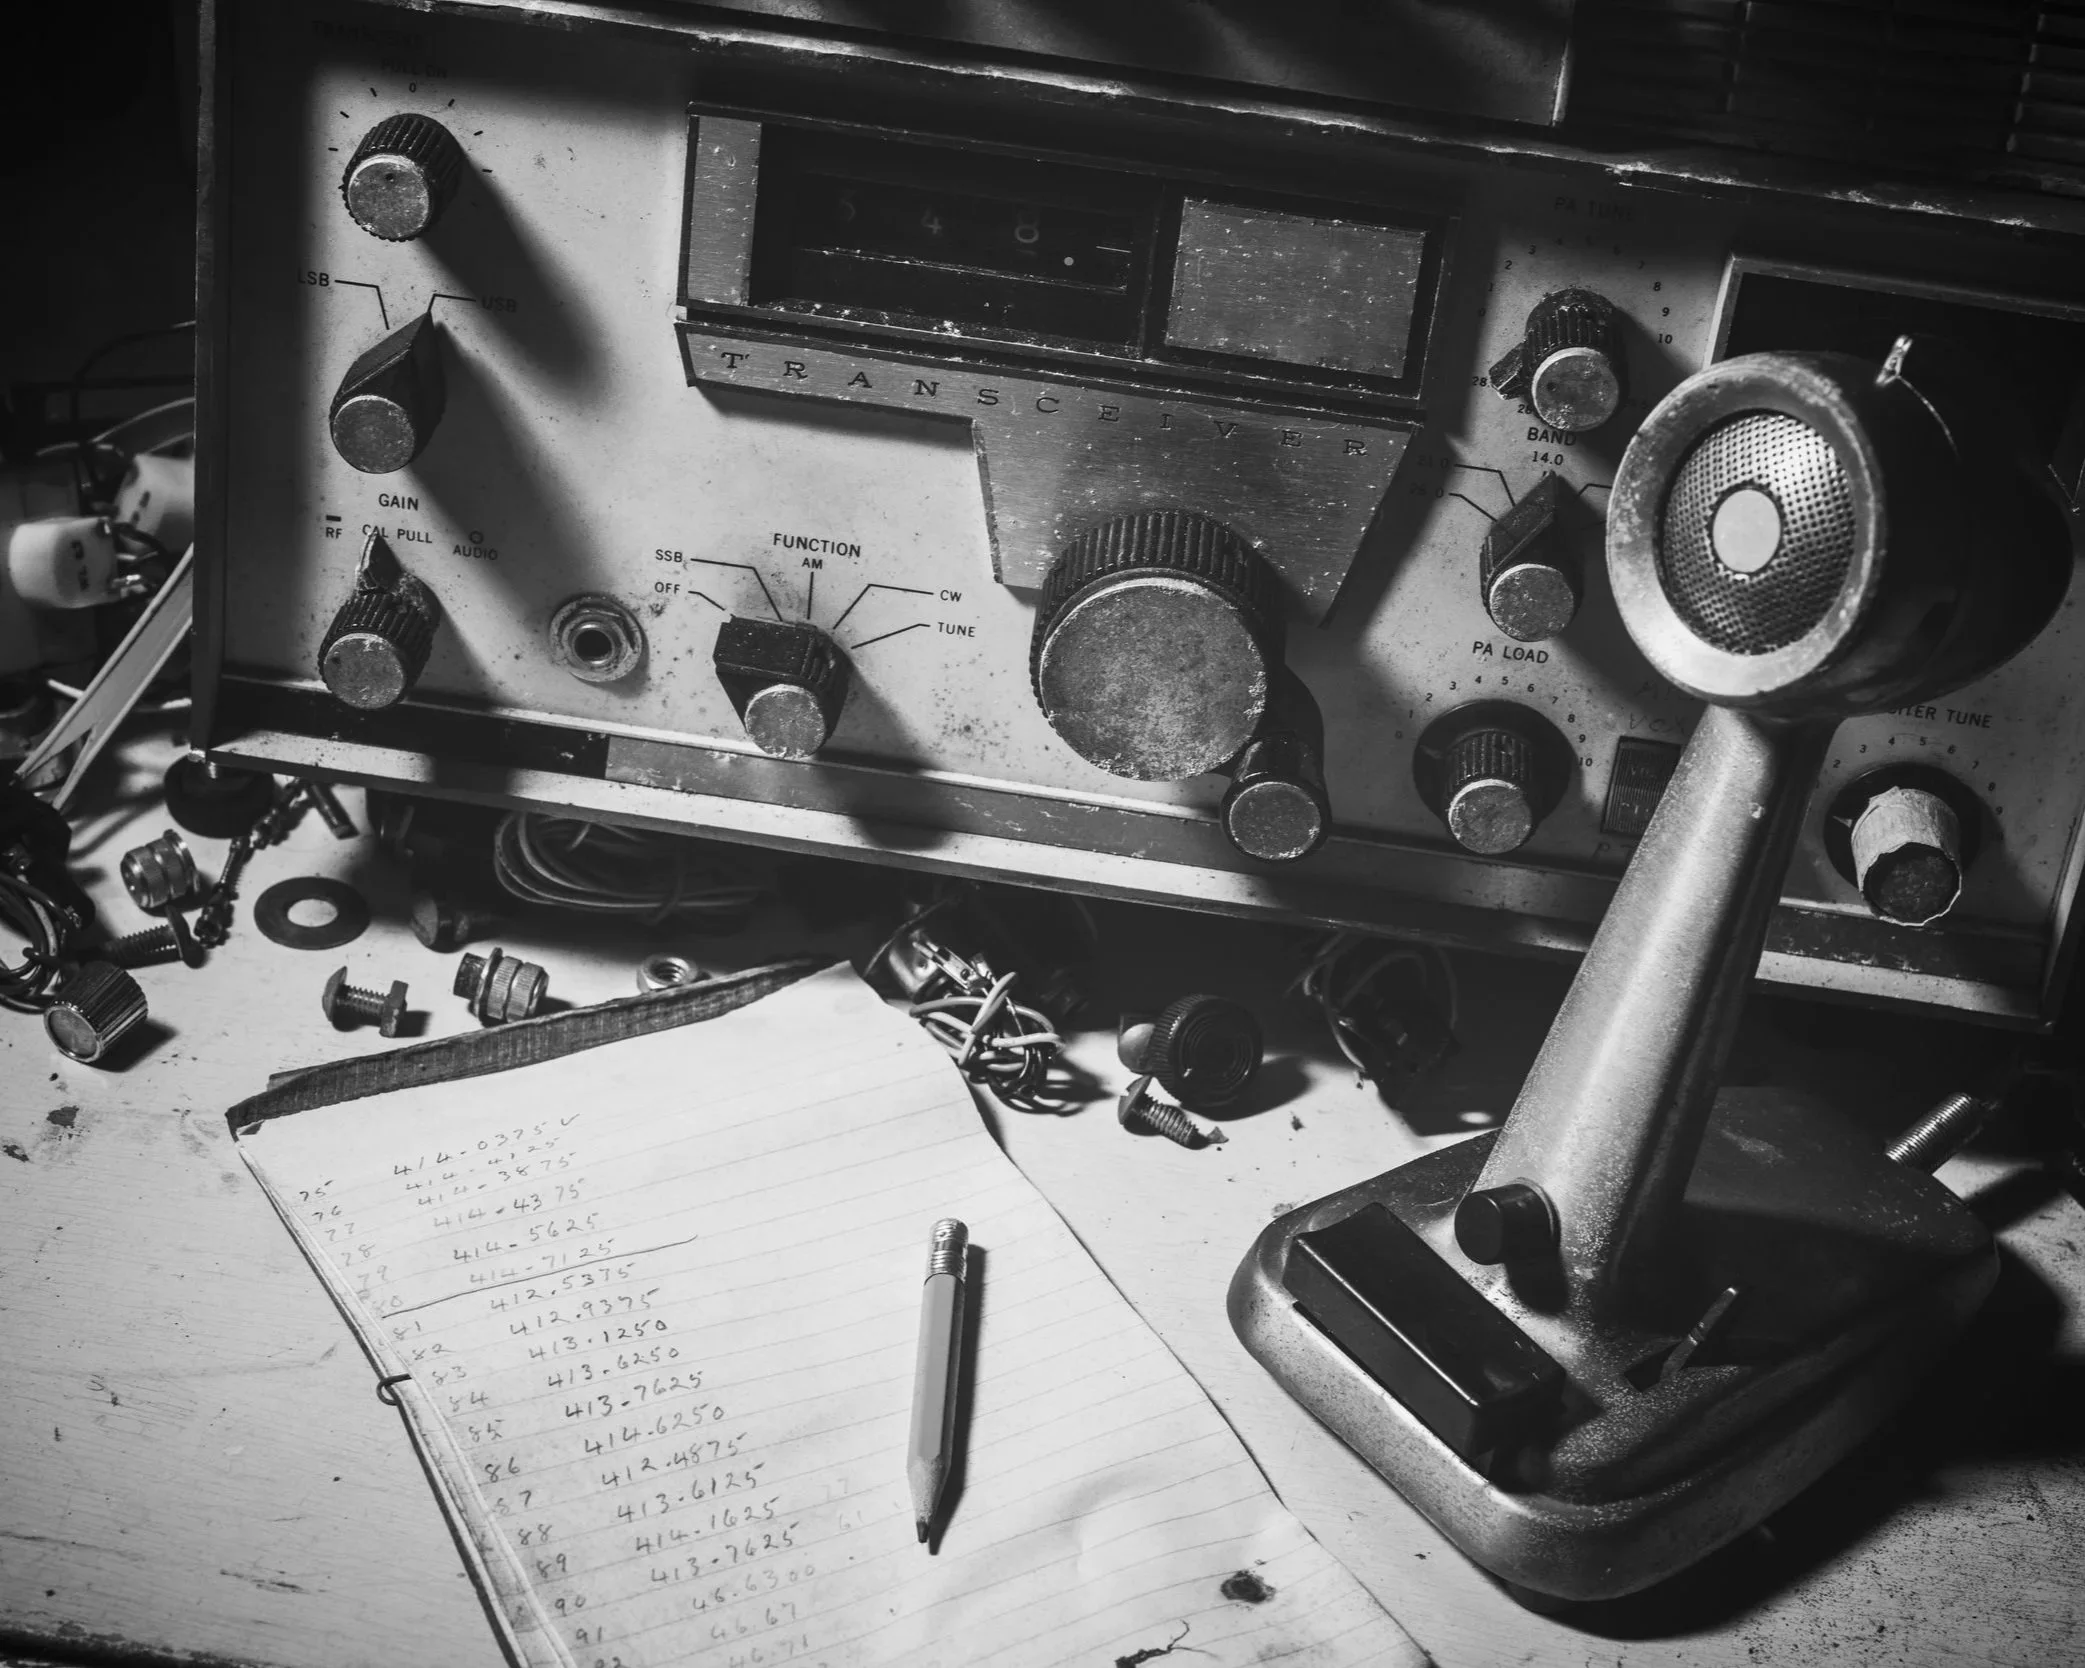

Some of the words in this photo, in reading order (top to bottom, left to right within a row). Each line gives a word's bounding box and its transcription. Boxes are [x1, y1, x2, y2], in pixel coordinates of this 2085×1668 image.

[1528, 244, 1537, 255] 3
[1504, 260, 1513, 270] 2
[1653, 281, 1662, 292] 8
[481, 293, 518, 313] USB
[1661, 307, 1670, 317] 9
[1657, 333, 1673, 345] 10
[721, 351, 1369, 457] TRANSCEIVER
[1527, 427, 1577, 446] BAND
[1531, 451, 1564, 466] 14.0
[378, 493, 419, 511] GAIN
[325, 527, 342, 539] RF
[362, 524, 389, 539] CAL
[397, 529, 433, 544] PULL
[452, 544, 498, 561] AUDIO
[773, 533, 861, 558] FUNCTION
[655, 549, 683, 563] SSB
[801, 557, 823, 570] AM
[654, 581, 680, 595] OFF
[940, 589, 961, 602] CW
[937, 621, 976, 637] TUNE
[1472, 641, 1494, 656] PA
[1503, 646, 1549, 665] LOAD
[1450, 681, 1457, 691] 3
[1475, 675, 1482, 685] 4
[1502, 676, 1509, 686] 5
[1527, 683, 1535, 693] 6
[1425, 692, 1433, 702] 2
[1551, 696, 1559, 705] 7
[1567, 713, 1576, 723] 8
[1947, 709, 1993, 729] TUNE
[1578, 733, 1587, 744] 9
[1888, 736, 1896, 746] 4
[1919, 736, 1927, 746] 5
[1859, 744, 1867, 754] 3
[1578, 757, 1593, 767] 10
[1833, 758, 1841, 769] 2
[299, 1179, 334, 1202] 75
[312, 1205, 342, 1222] 76
[432, 1365, 467, 1386] 83
[449, 1391, 489, 1413] 84
[484, 1456, 521, 1484] 86
[518, 1524, 552, 1546] 88
[536, 1553, 567, 1579] 89
[554, 1594, 587, 1618] 90
[575, 1626, 603, 1645] 91
